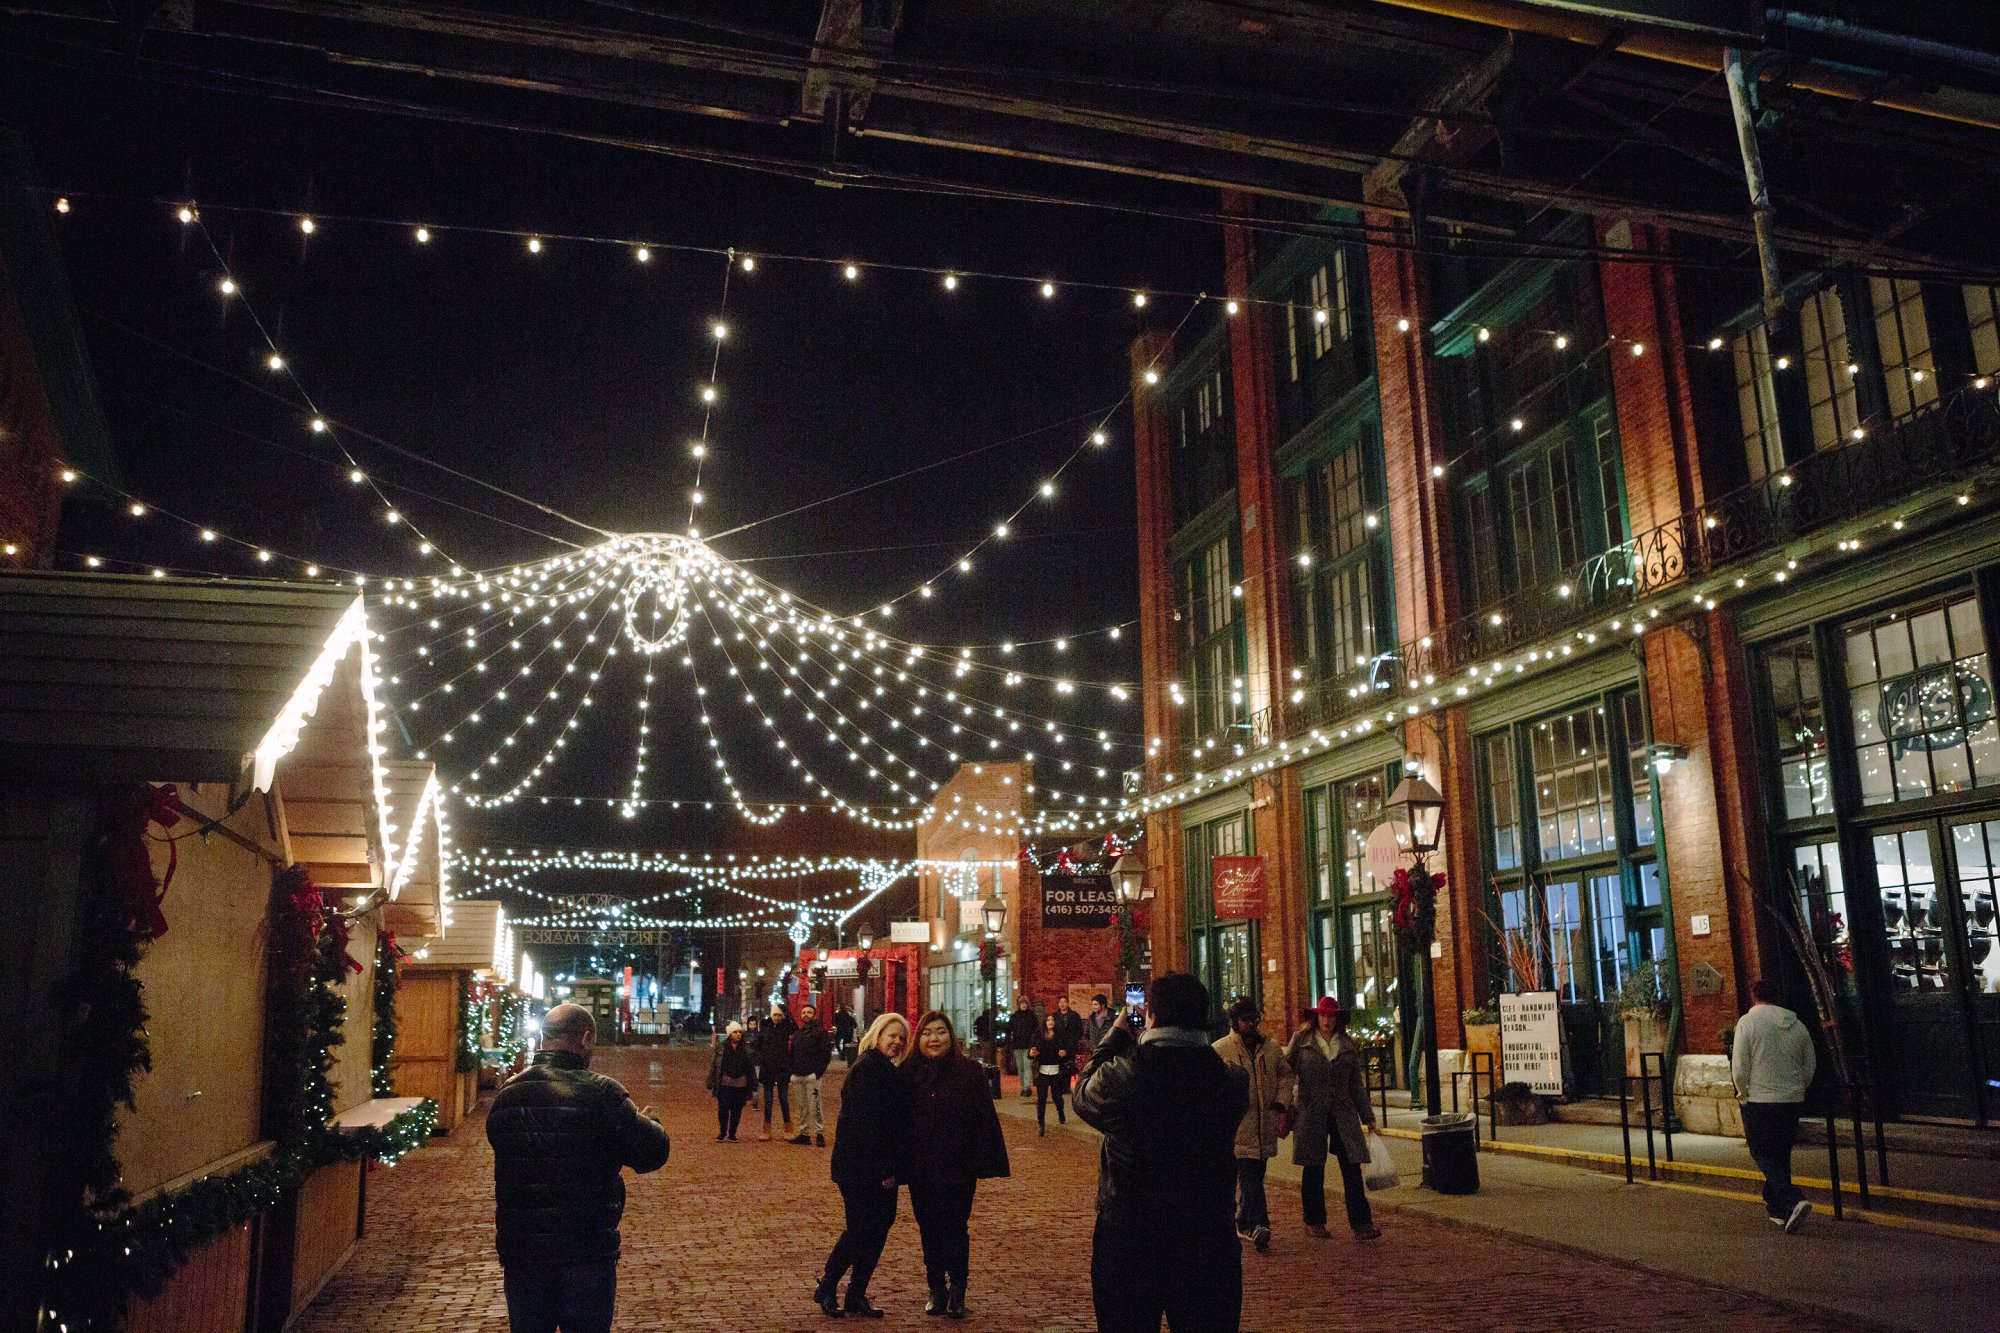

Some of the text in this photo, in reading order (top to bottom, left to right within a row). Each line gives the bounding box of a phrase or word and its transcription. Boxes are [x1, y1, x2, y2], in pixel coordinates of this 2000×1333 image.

[1046, 890, 1115, 902] FOR LEAS
[1045, 905, 1125, 915] (416) 507-3450
[1521, 1003, 1555, 1012] HANDMADE
[1504, 1012, 1546, 1022] THIS HOLIDAY
[1505, 1053, 1537, 1061] BEAUTIFUL
[1505, 1062, 1520, 1071] OVER
[1535, 1082, 1560, 1090] CANADA
